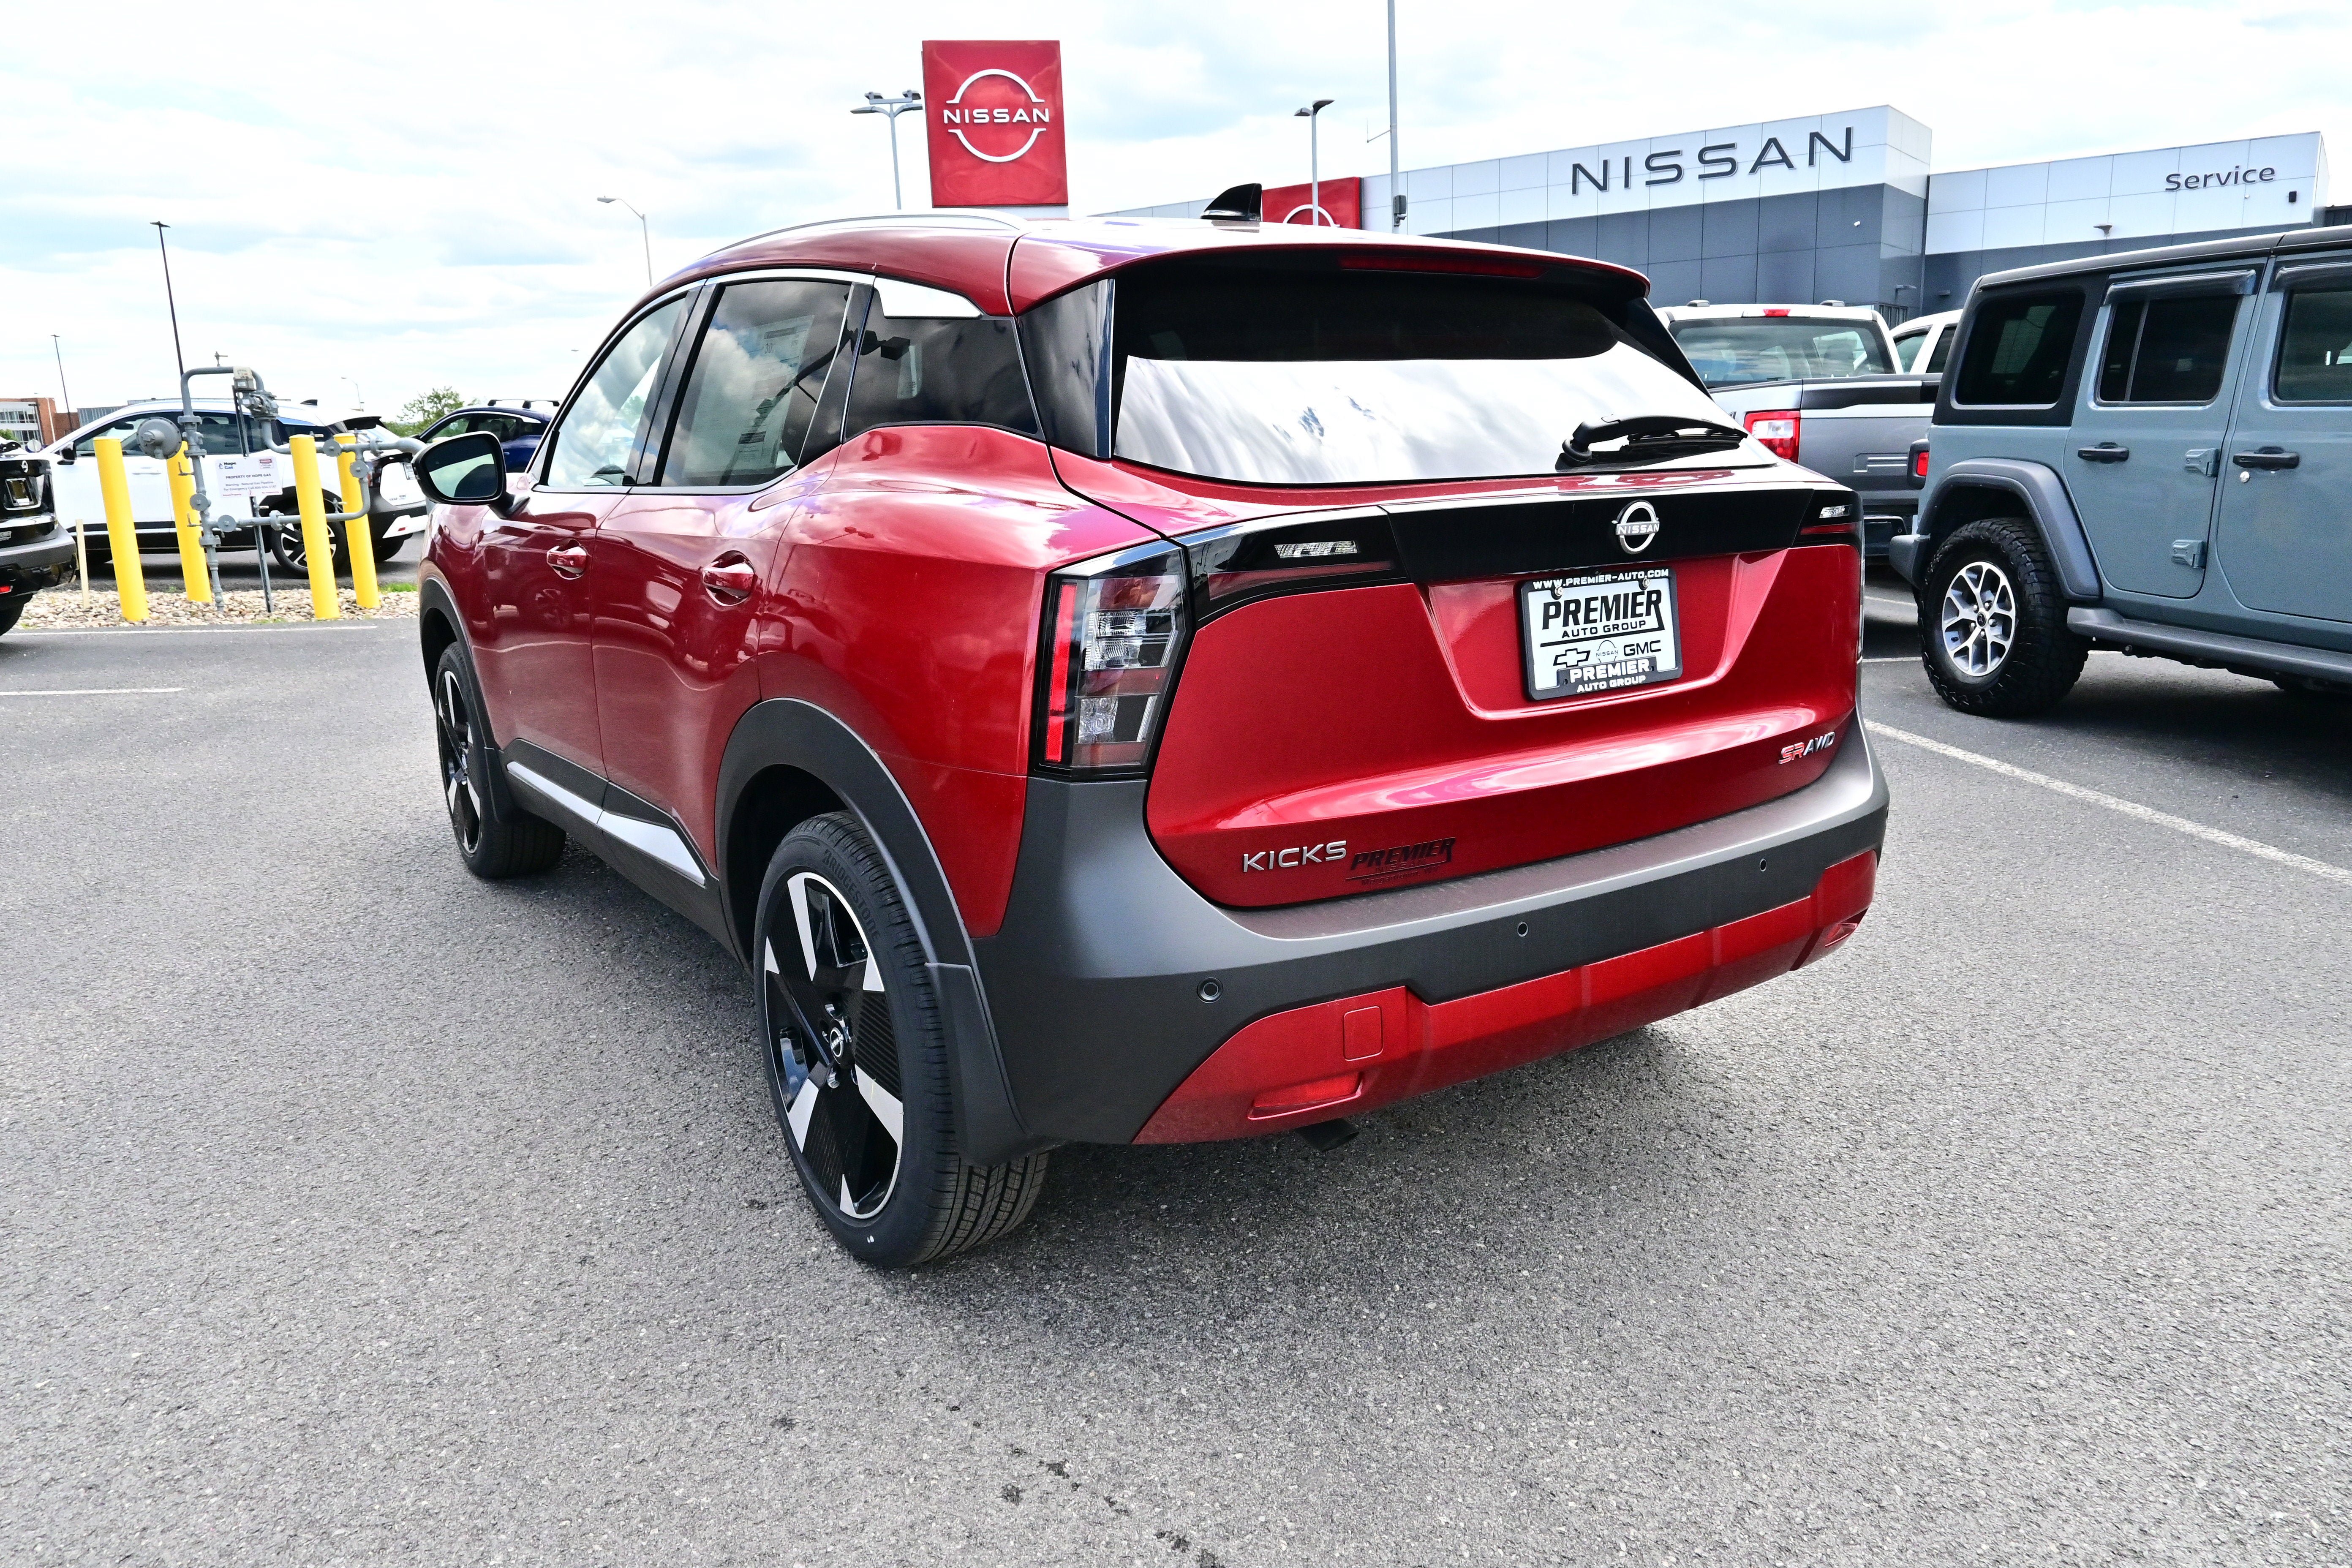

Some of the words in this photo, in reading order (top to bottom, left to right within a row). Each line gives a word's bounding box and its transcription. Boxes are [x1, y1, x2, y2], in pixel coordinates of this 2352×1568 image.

[943, 108, 1050, 124] NISSAN
[1572, 126, 1853, 195] NISSAN
[2165, 165, 2276, 192] Service
[1618, 524, 1659, 534] NISSAN
[1533, 569, 1669, 590] WWW.PREMIER-AUTO.COM
[1542, 589, 1665, 630] PREMIER
[1562, 626, 1598, 639] AUTO
[1603, 620, 1646, 633] GROUP
[1596, 649, 1618, 657] NISSAN
[1623, 640, 1661, 656] GMC
[1569, 659, 1650, 683] PREMIER
[1576, 681, 1607, 693] AUTO
[1609, 675, 1646, 688] GROUP
[1778, 742, 1805, 764] SR
[1803, 731, 1835, 756] AWD
[1243, 840, 1347, 873] KICKS
[1350, 836, 1456, 870] PREMIER
[1375, 858, 1425, 873] NISSAN
[823, 849, 881, 942] BRIDGESTONE
